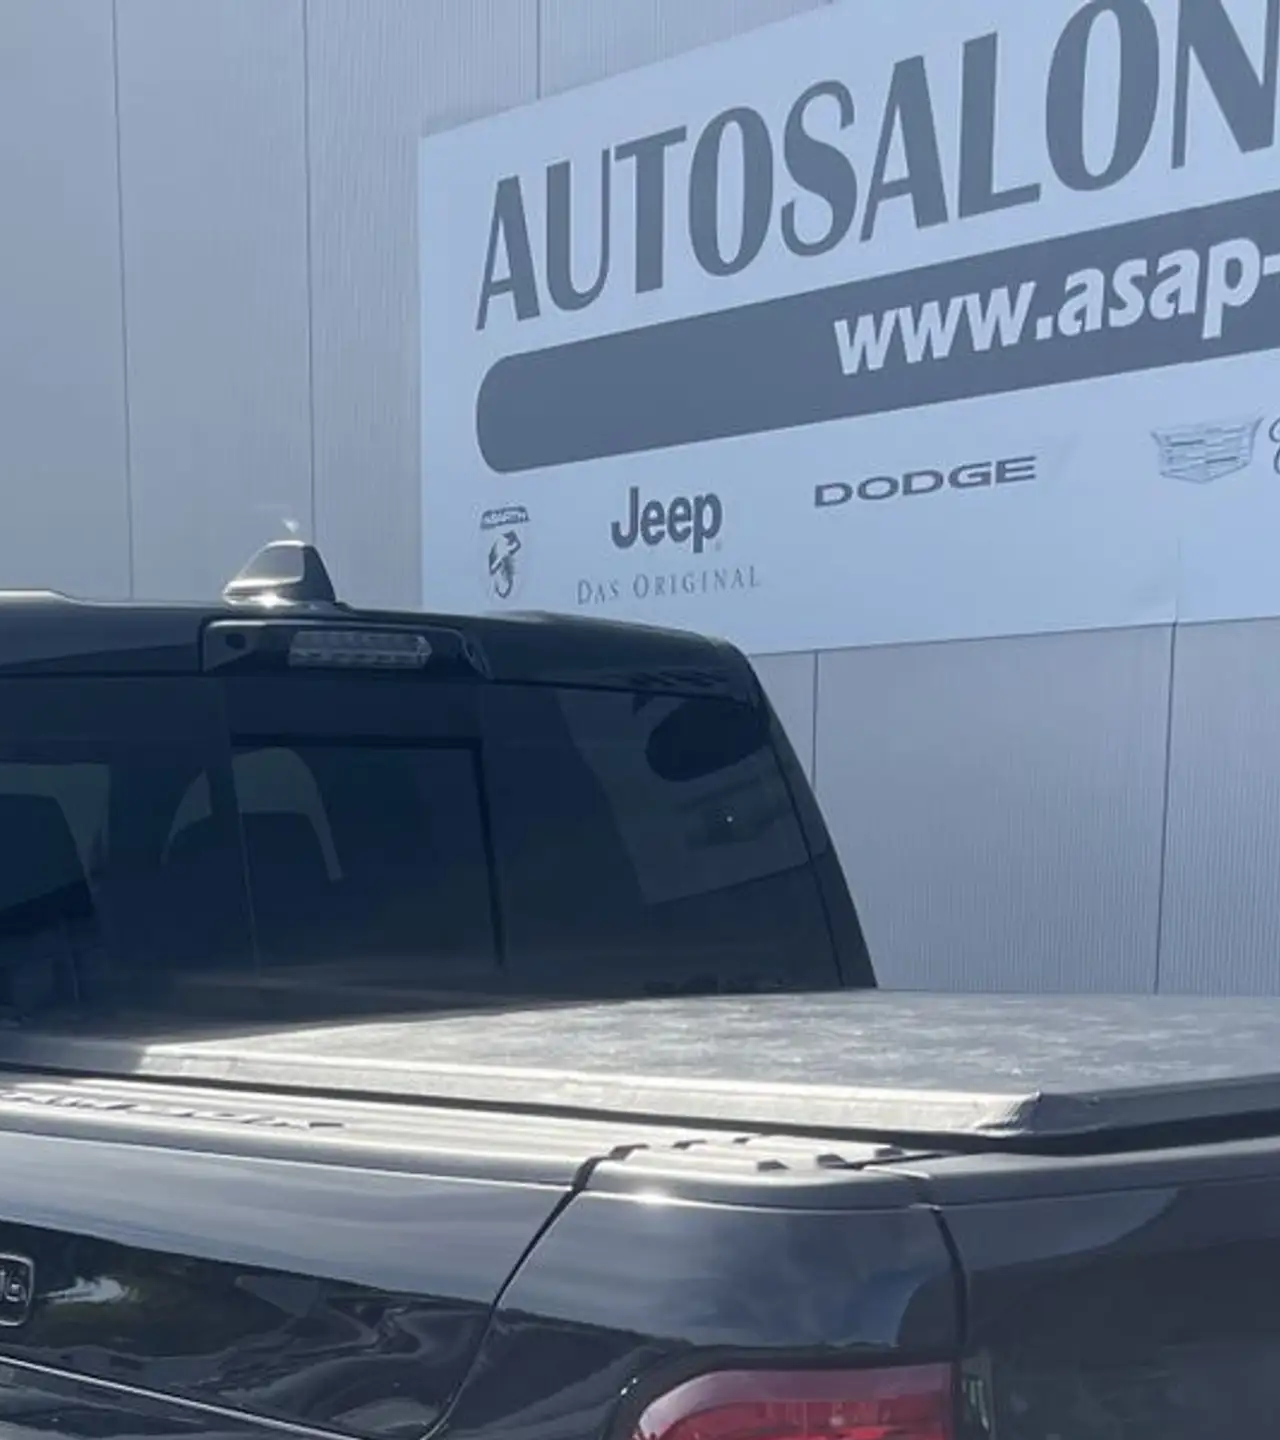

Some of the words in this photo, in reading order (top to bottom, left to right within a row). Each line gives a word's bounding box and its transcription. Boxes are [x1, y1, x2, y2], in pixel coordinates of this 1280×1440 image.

[475, 0, 1280, 331] AUTOSALON
[814, 455, 1037, 508] DODGE
[610, 486, 723, 554] Jeep
